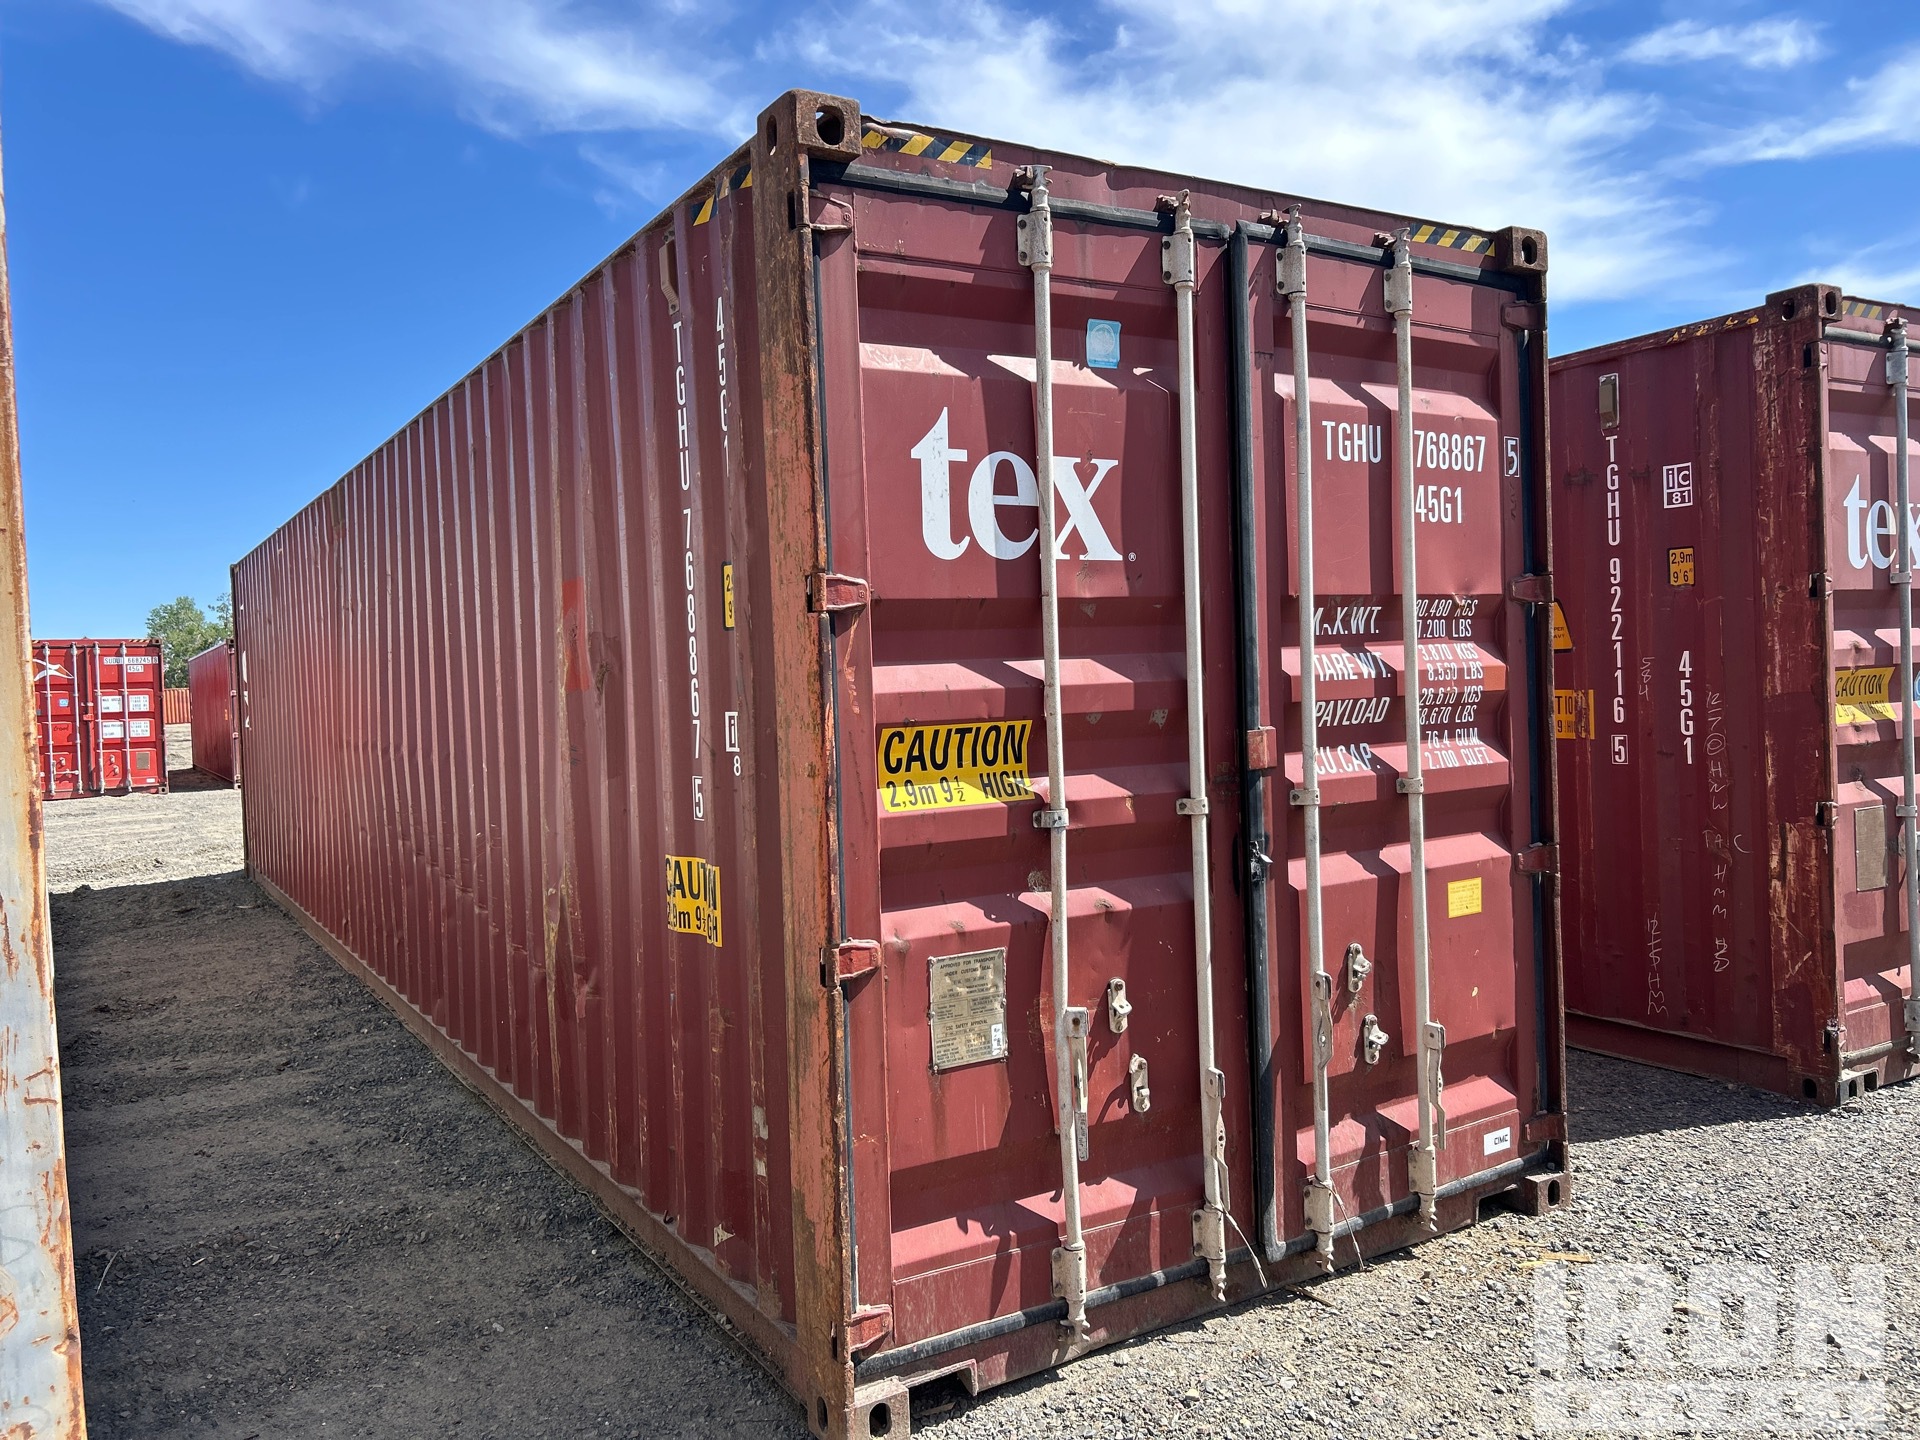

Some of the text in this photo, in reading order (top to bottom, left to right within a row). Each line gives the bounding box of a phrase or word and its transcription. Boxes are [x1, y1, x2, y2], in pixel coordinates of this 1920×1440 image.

[1322, 421, 1518, 475] TGHU 768867 5
[1415, 484, 1463, 524] 45G1
[1672, 490, 1690, 504] 81
[673, 321, 704, 818] TGHU 768867 5
[1605, 435, 1625, 763] TGHU 922116 5
[1452, 618, 1472, 638] LBS
[1453, 643, 1479, 660] KGS
[1461, 661, 1483, 680] LBS
[1835, 674, 1885, 697] CAUTION
[1461, 685, 1483, 704] KGS
[1678, 651, 1694, 764] 45G1
[1315, 697, 1390, 728] PAYLOAD
[1455, 705, 1477, 723] LBS
[884, 724, 1027, 774] CAUTION
[886, 779, 939, 808] 2,9m
[979, 770, 1031, 799] HIGH
